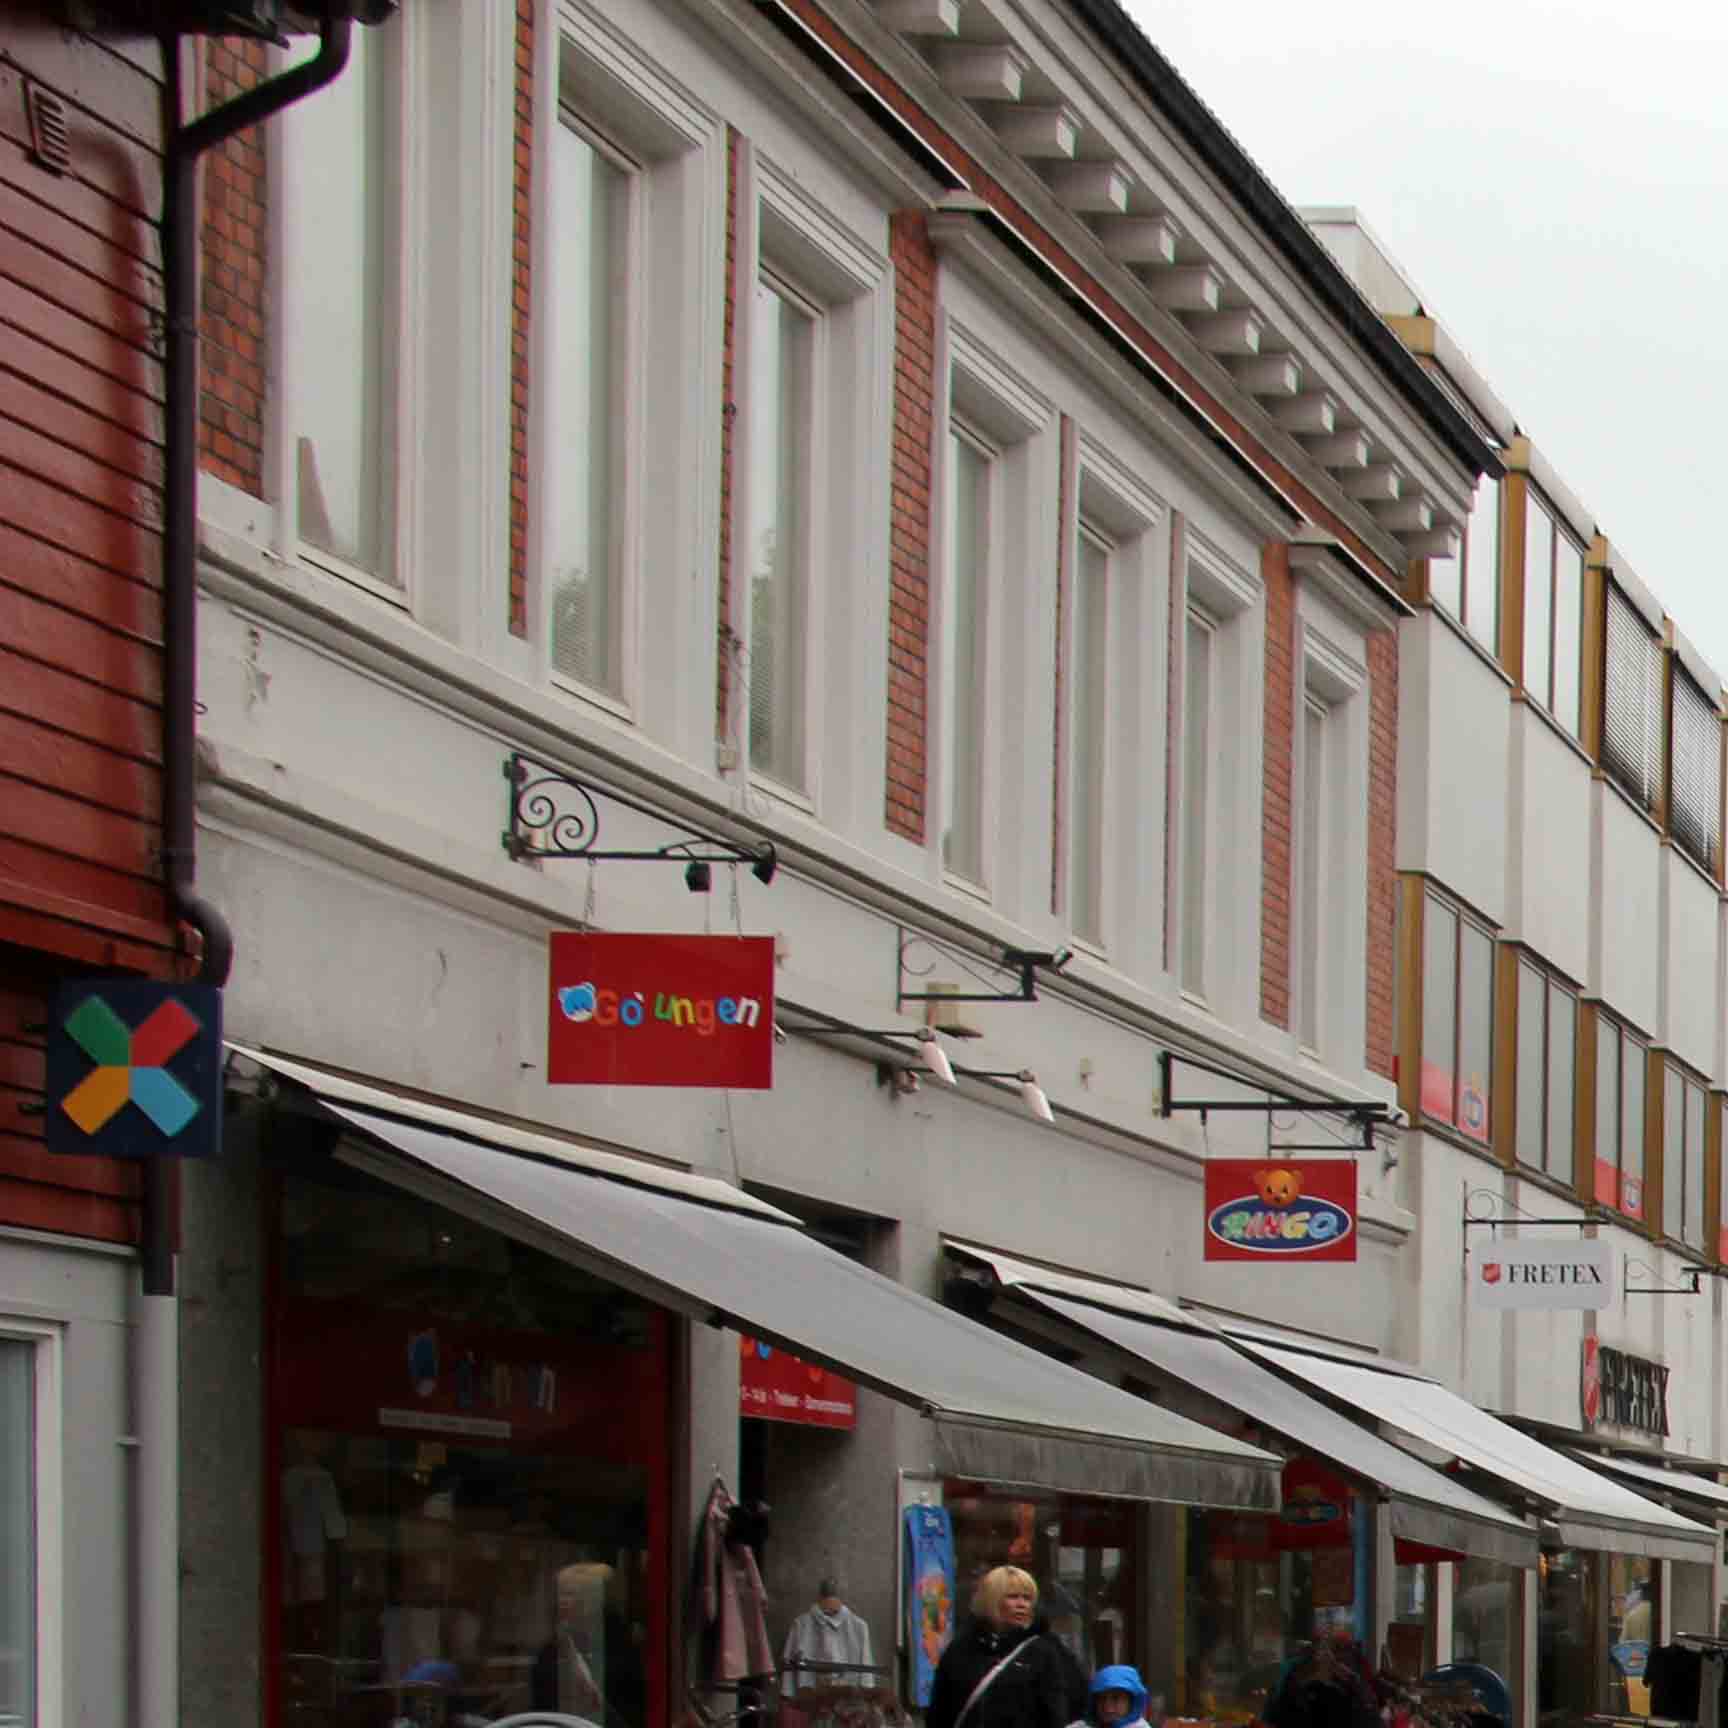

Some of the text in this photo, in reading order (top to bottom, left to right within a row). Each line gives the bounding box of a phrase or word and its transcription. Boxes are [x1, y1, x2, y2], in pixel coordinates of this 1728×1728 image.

[654, 991, 762, 1036] ungen
[1221, 1211, 1338, 1240] RINGO
[1506, 1263, 1602, 1284] FRETEX
[1599, 1346, 1671, 1437] FRETEX
